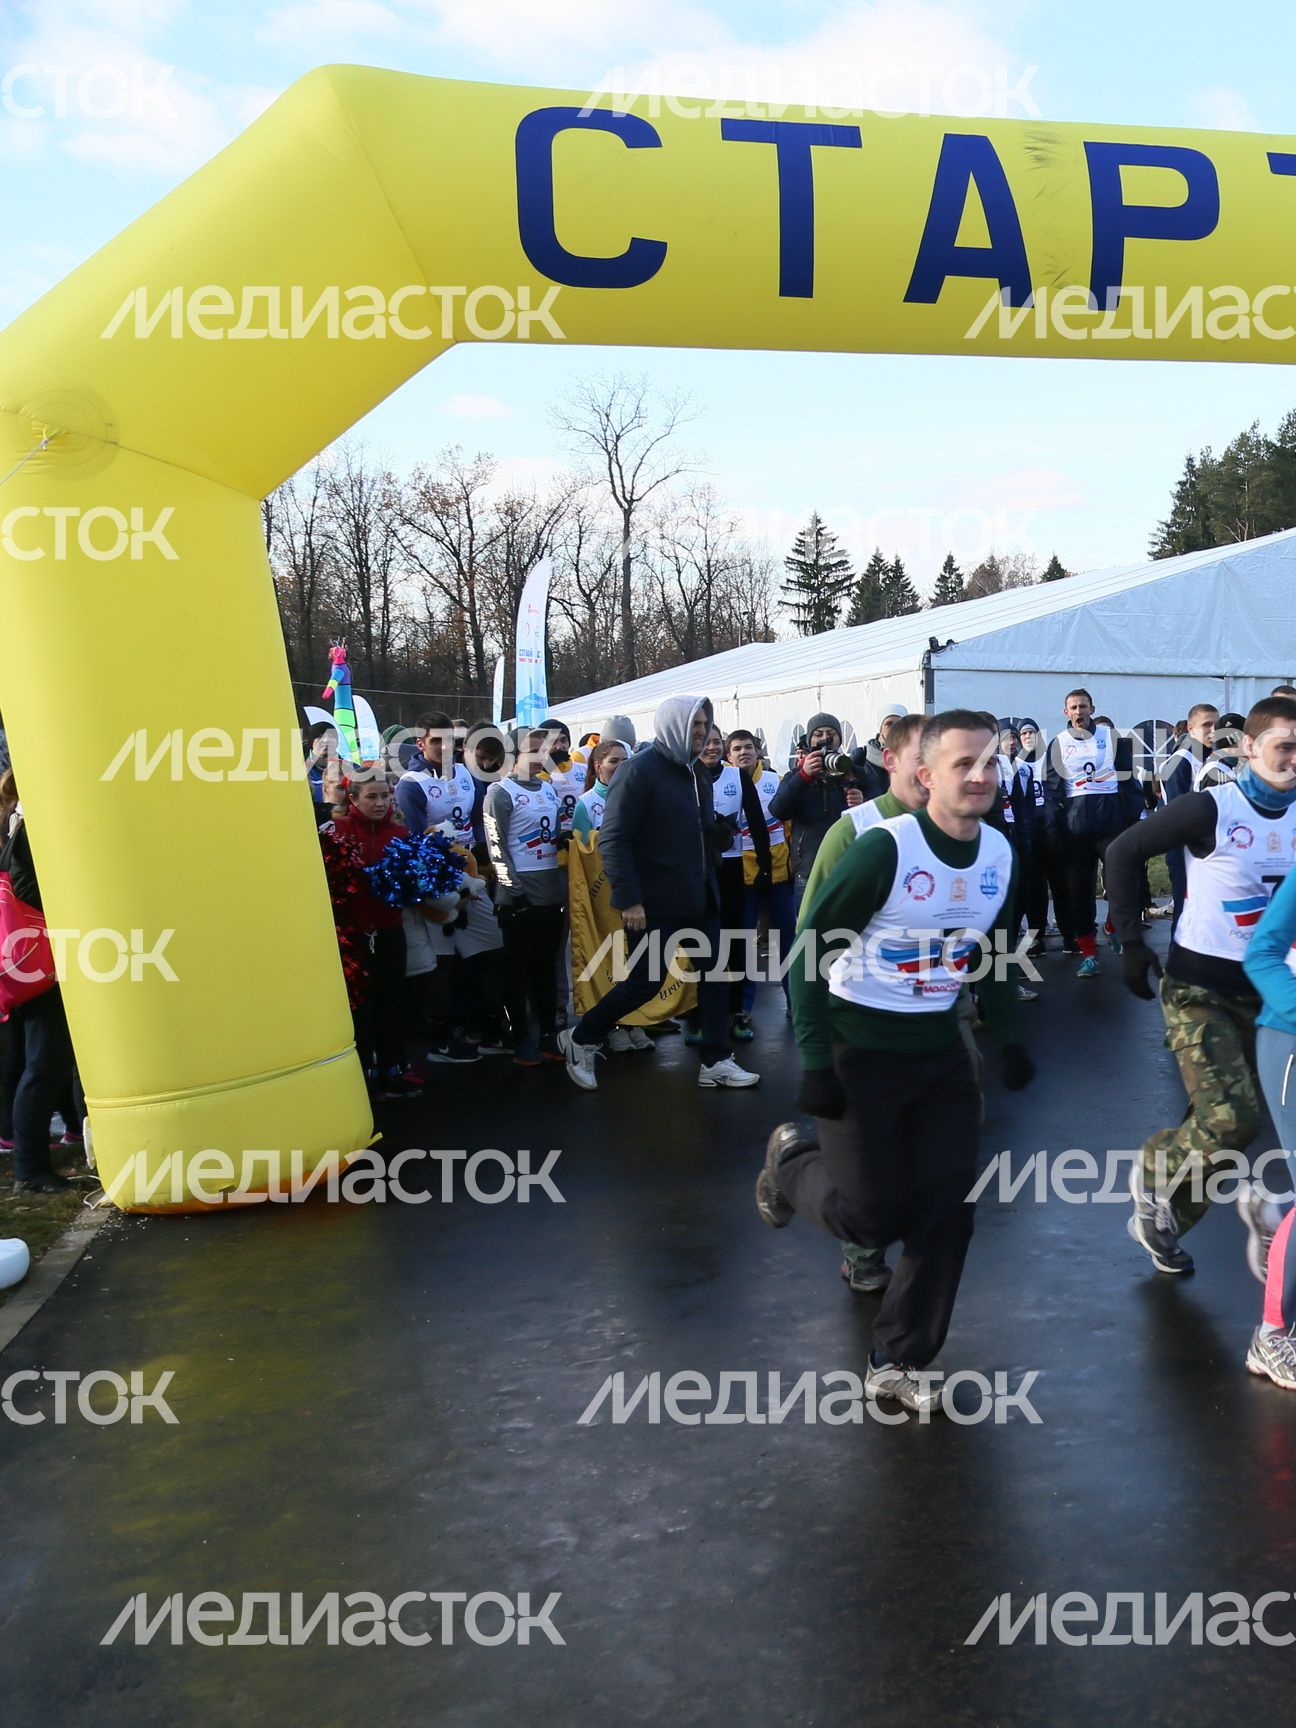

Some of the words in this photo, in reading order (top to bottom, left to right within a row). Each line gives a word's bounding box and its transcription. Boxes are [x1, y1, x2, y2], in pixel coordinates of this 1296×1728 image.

[452, 806, 464, 830] 8
[563, 794, 577, 819] 8
[540, 815, 551, 844] 8
